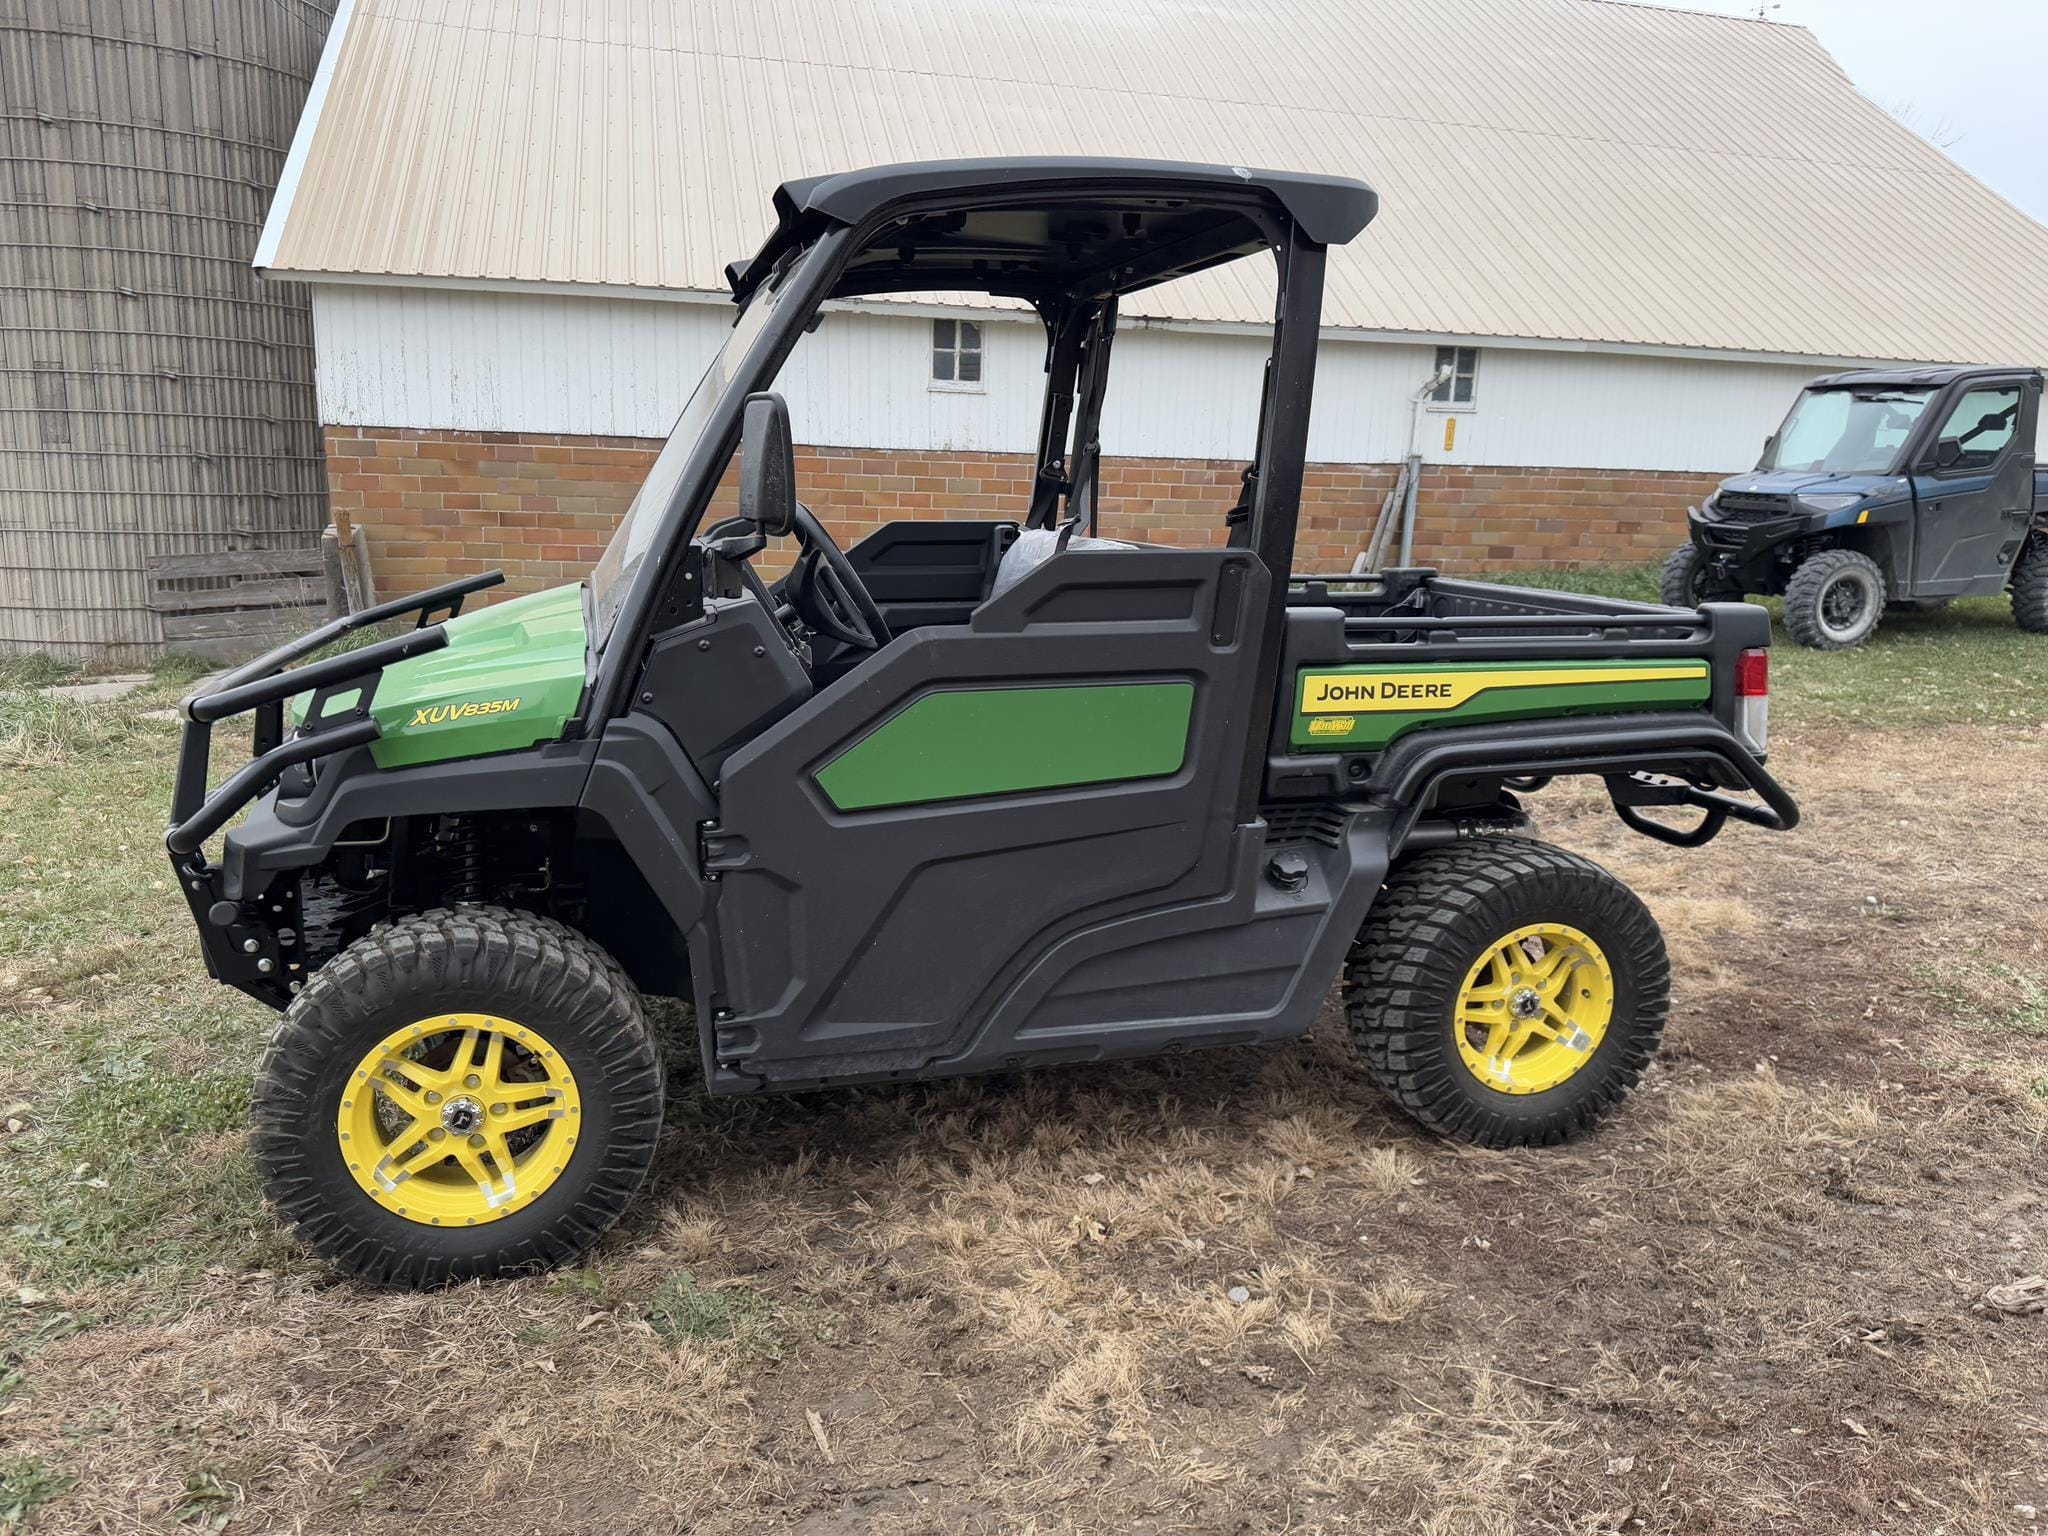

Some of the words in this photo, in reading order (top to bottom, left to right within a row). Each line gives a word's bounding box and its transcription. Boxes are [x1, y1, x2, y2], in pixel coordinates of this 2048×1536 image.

[1317, 683, 1375, 701] JOHN
[1381, 682, 1452, 699] DEERE
[409, 698, 521, 727] XUV835M
